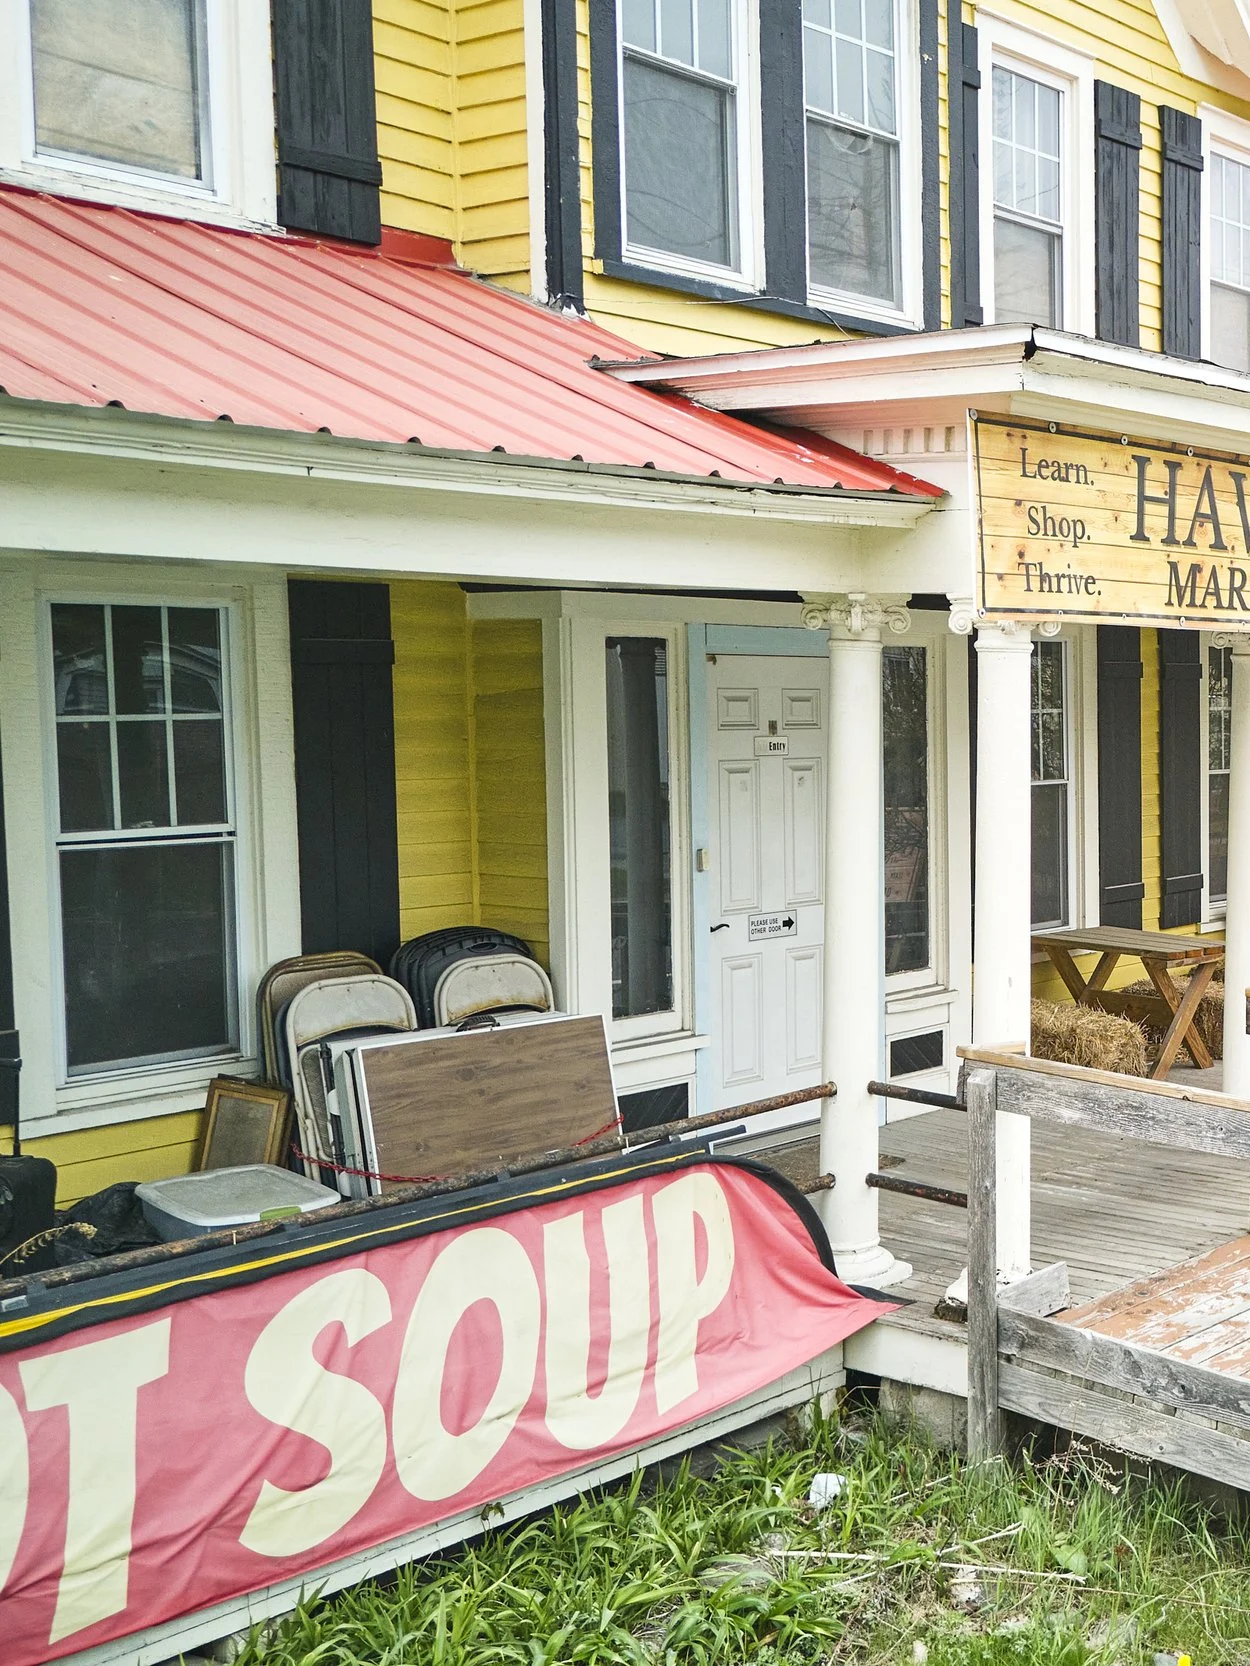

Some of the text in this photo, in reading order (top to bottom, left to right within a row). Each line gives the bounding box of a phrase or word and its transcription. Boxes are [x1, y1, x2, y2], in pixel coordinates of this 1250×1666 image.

[1020, 447, 1095, 487] Learn.
[1027, 505, 1091, 548] Shop.
[1017, 562, 1102, 596] Thrive.
[769, 741, 786, 752] Entry
[751, 917, 778, 927] PLEASE USE
[751, 925, 781, 935] OTHER DOOR
[239, 1171, 734, 1557] SOUP
